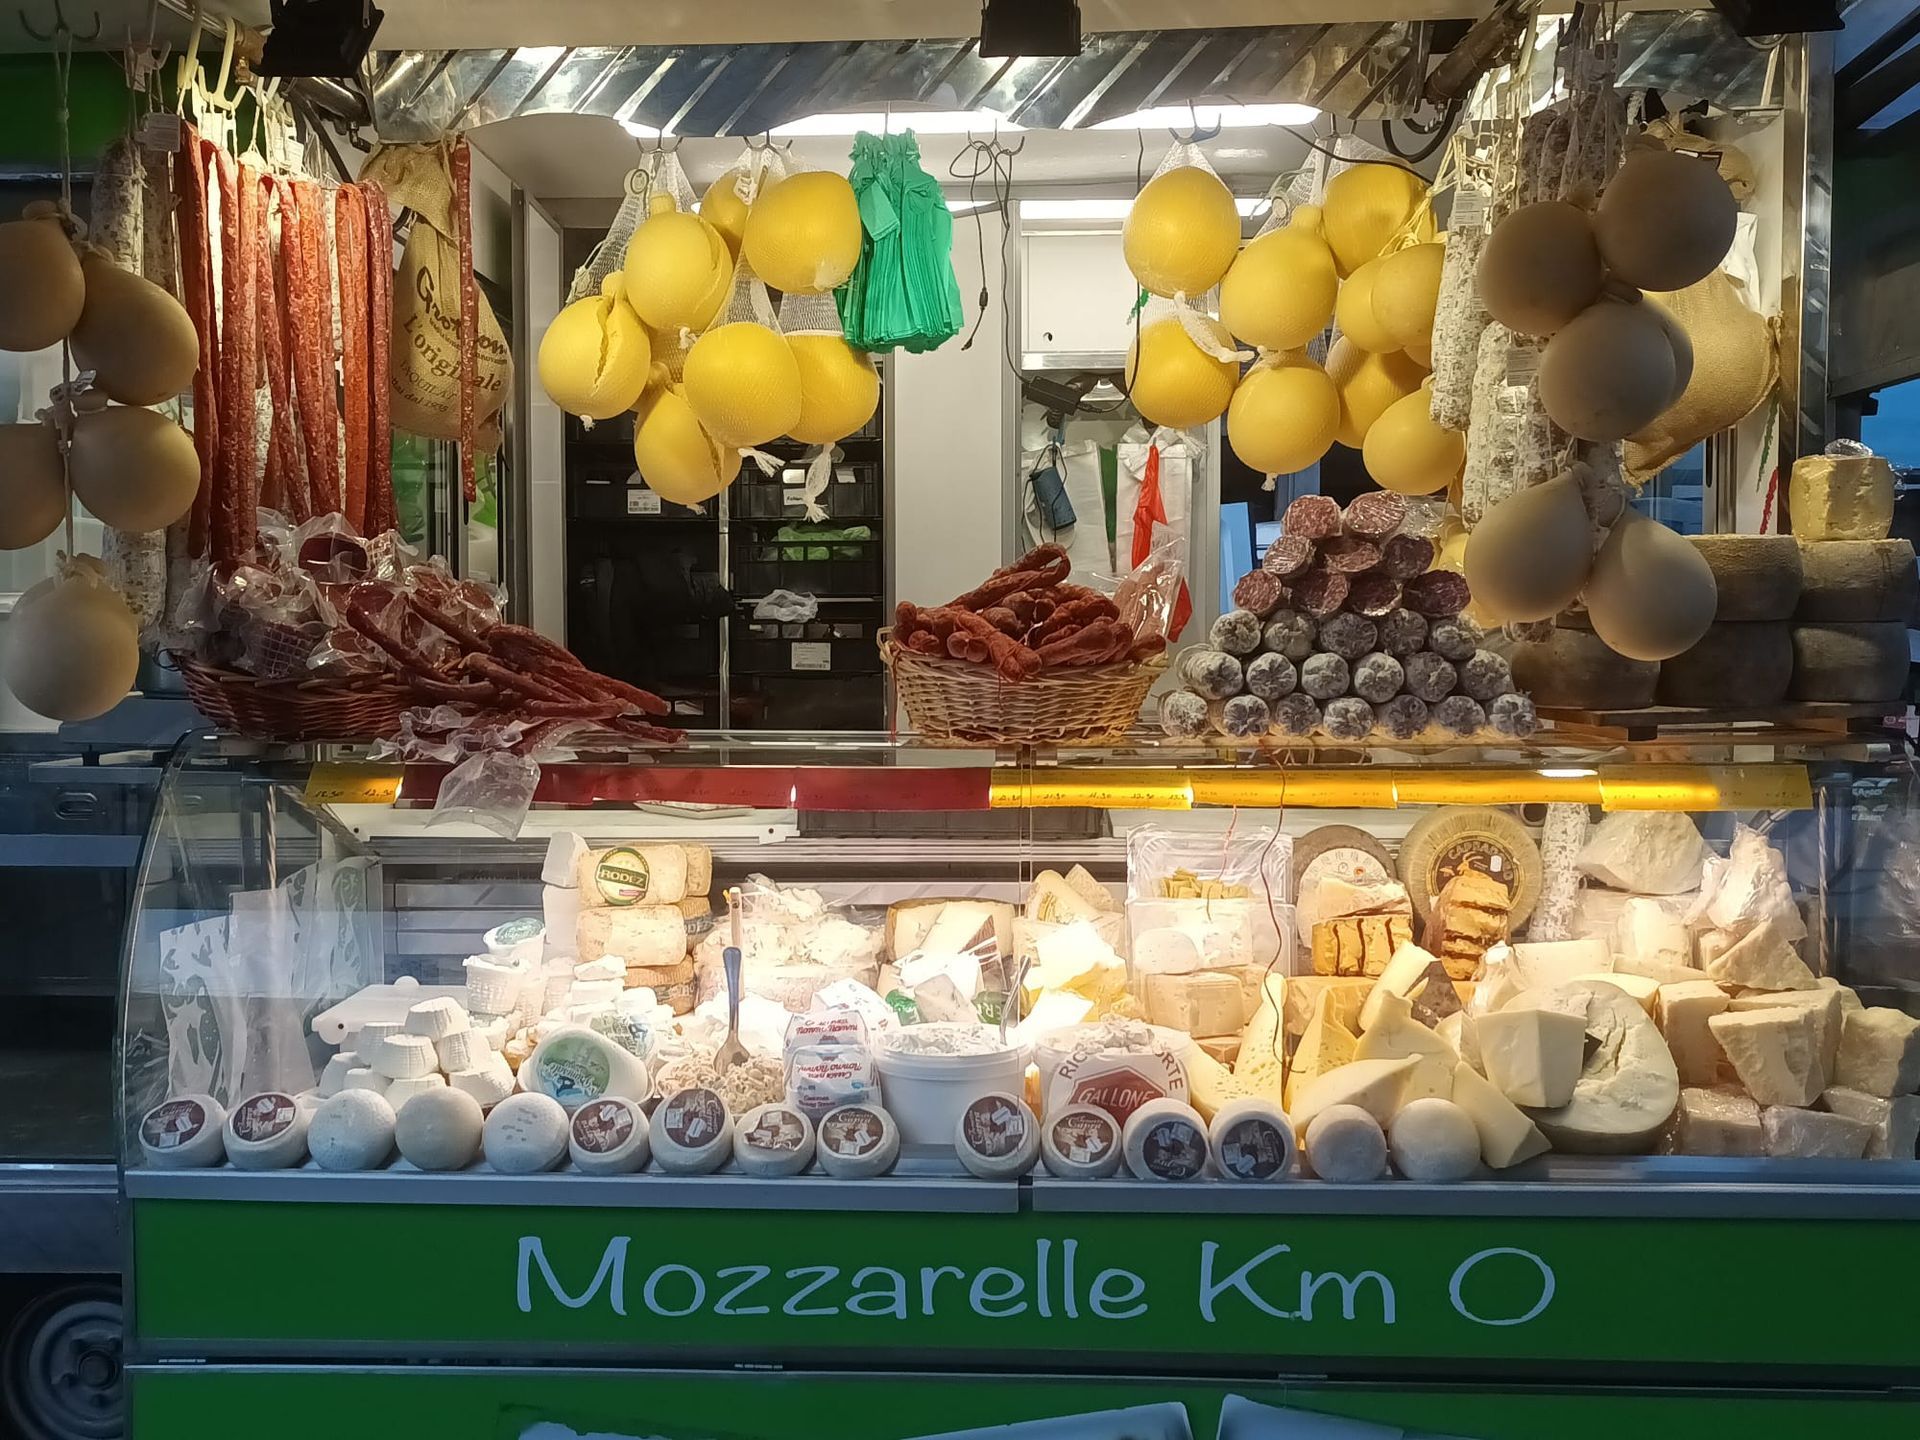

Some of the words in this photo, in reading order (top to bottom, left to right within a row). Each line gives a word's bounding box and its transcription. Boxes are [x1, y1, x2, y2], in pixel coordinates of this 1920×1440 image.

[403, 313, 502, 392] L'origiale
[516, 1236, 1148, 1319] Mozzarelle
[1199, 1240, 1395, 1323] Km
